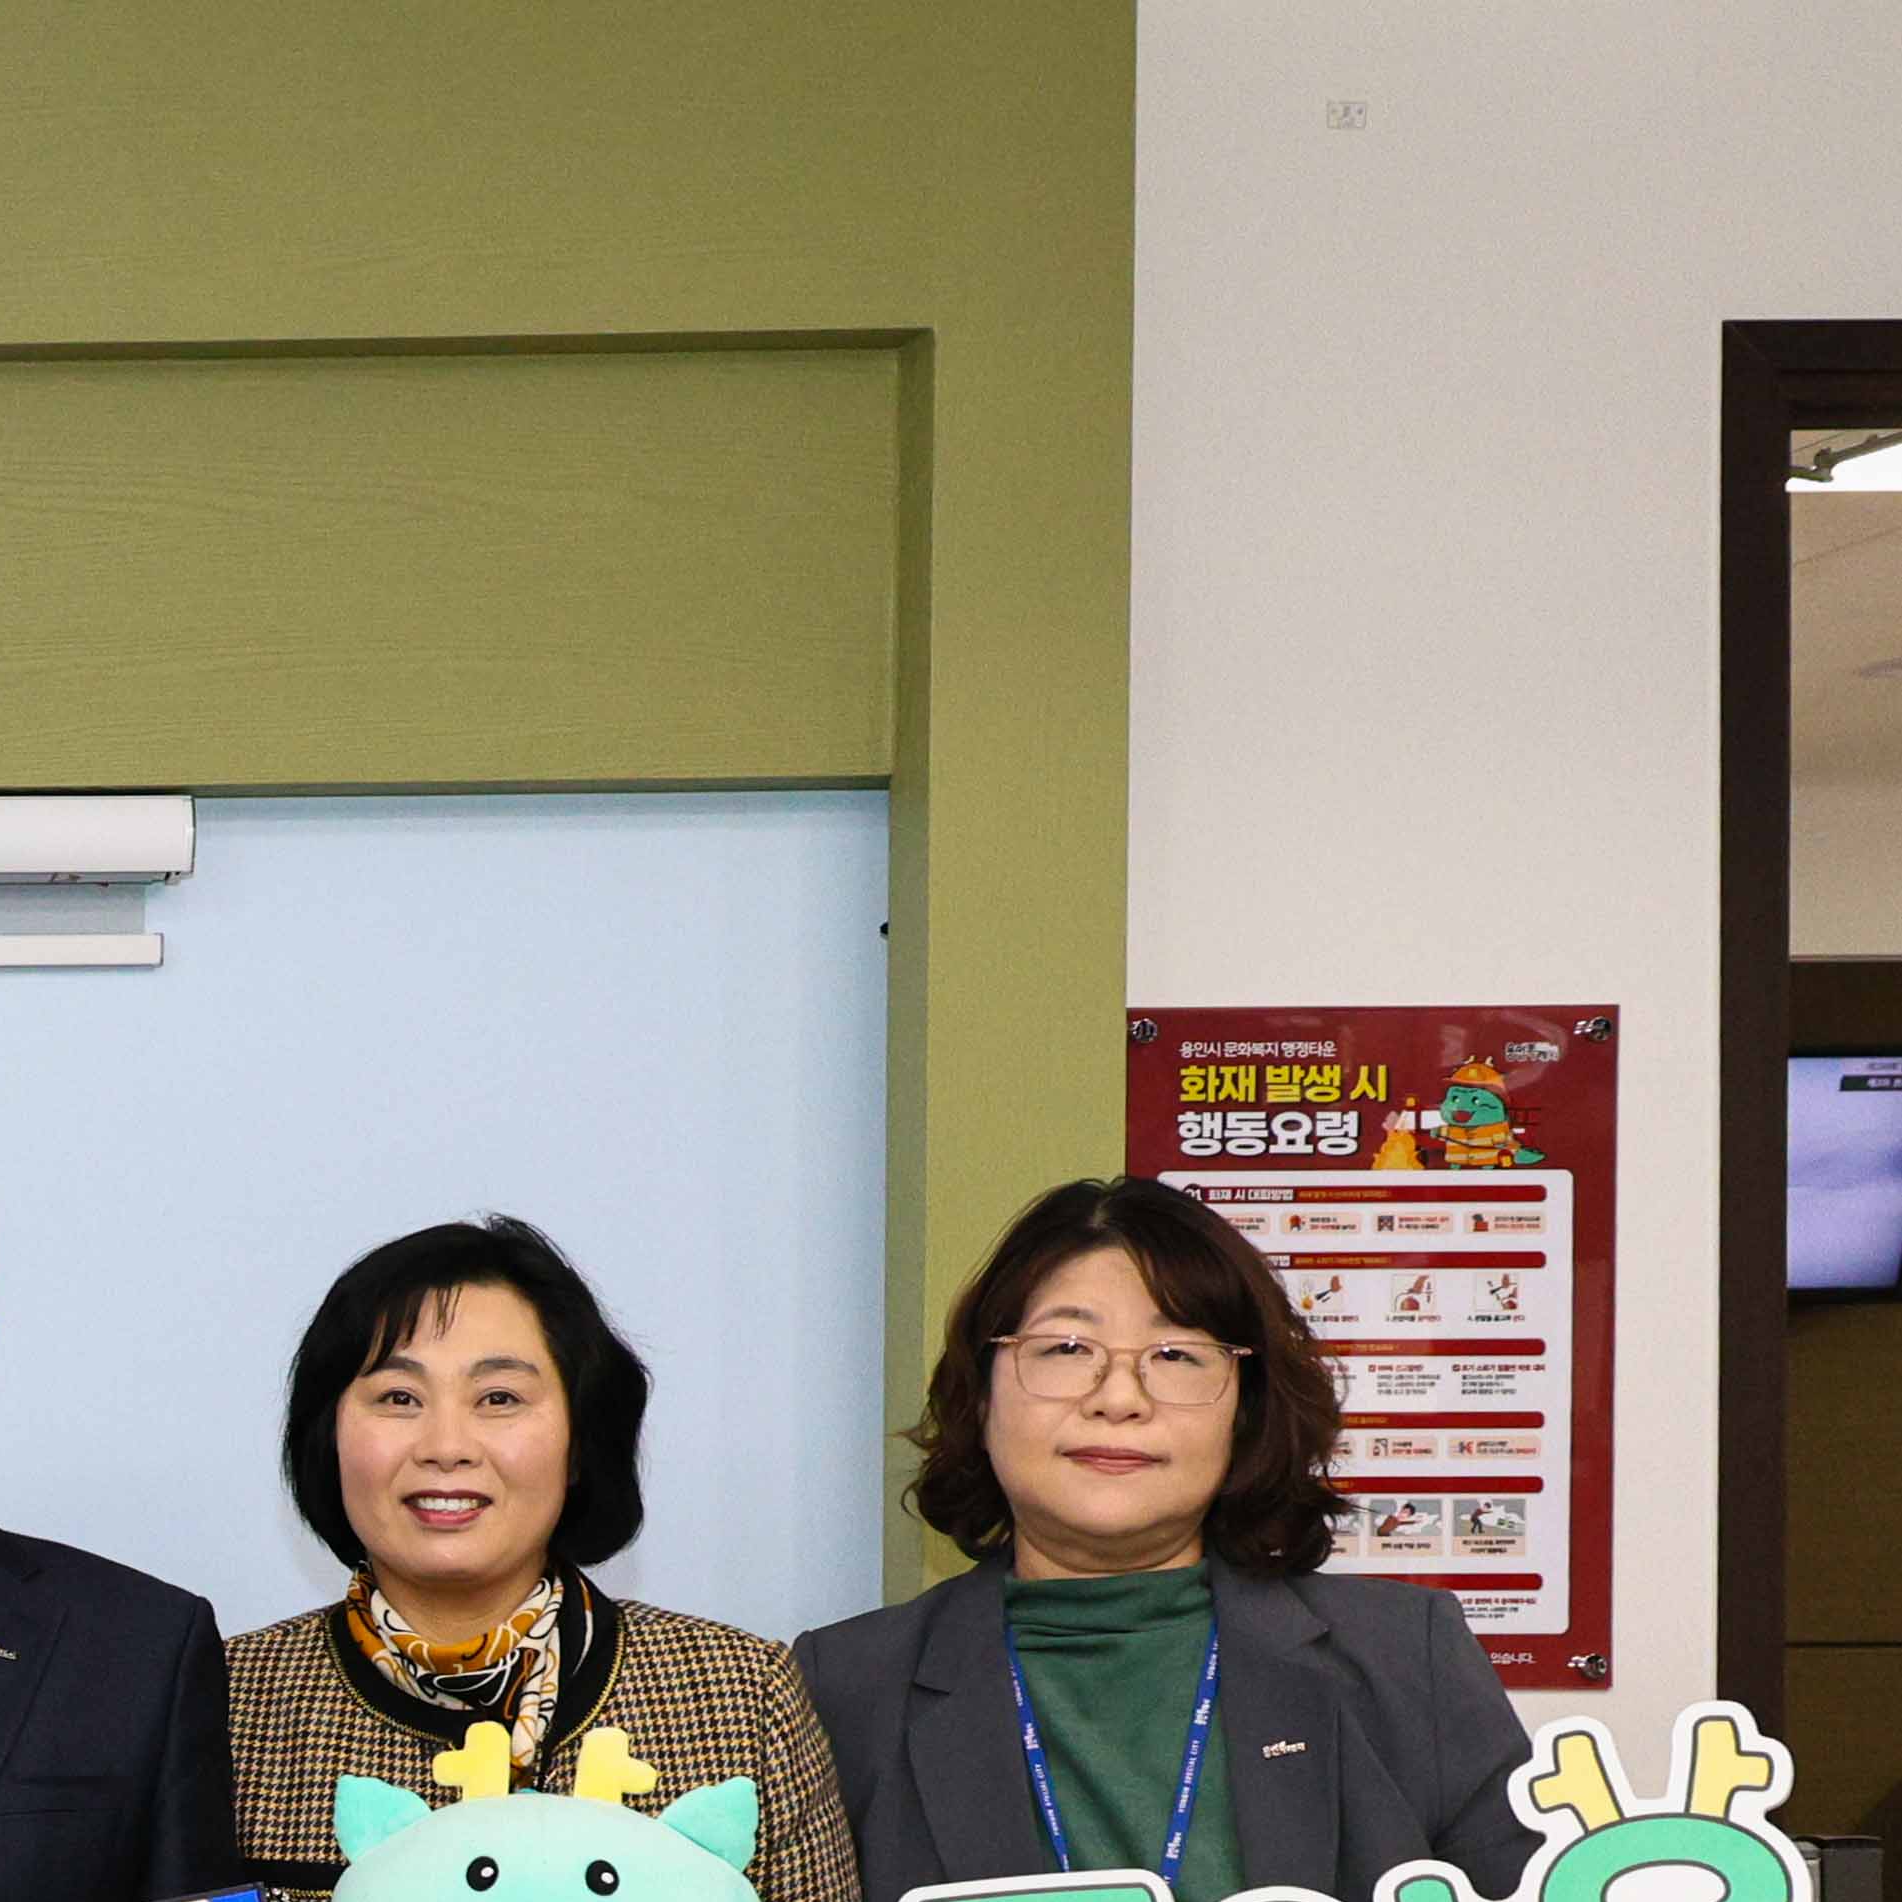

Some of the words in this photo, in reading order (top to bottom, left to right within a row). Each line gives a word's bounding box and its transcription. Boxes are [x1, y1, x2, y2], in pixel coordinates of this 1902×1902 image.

[1180, 1041, 1222, 1058] 용인시
[1180, 1064, 1257, 1103] 화재
[1265, 1064, 1342, 1103] 발생
[1349, 1064, 1387, 1102] 시
[1177, 1110, 1359, 1157] 행동요령
